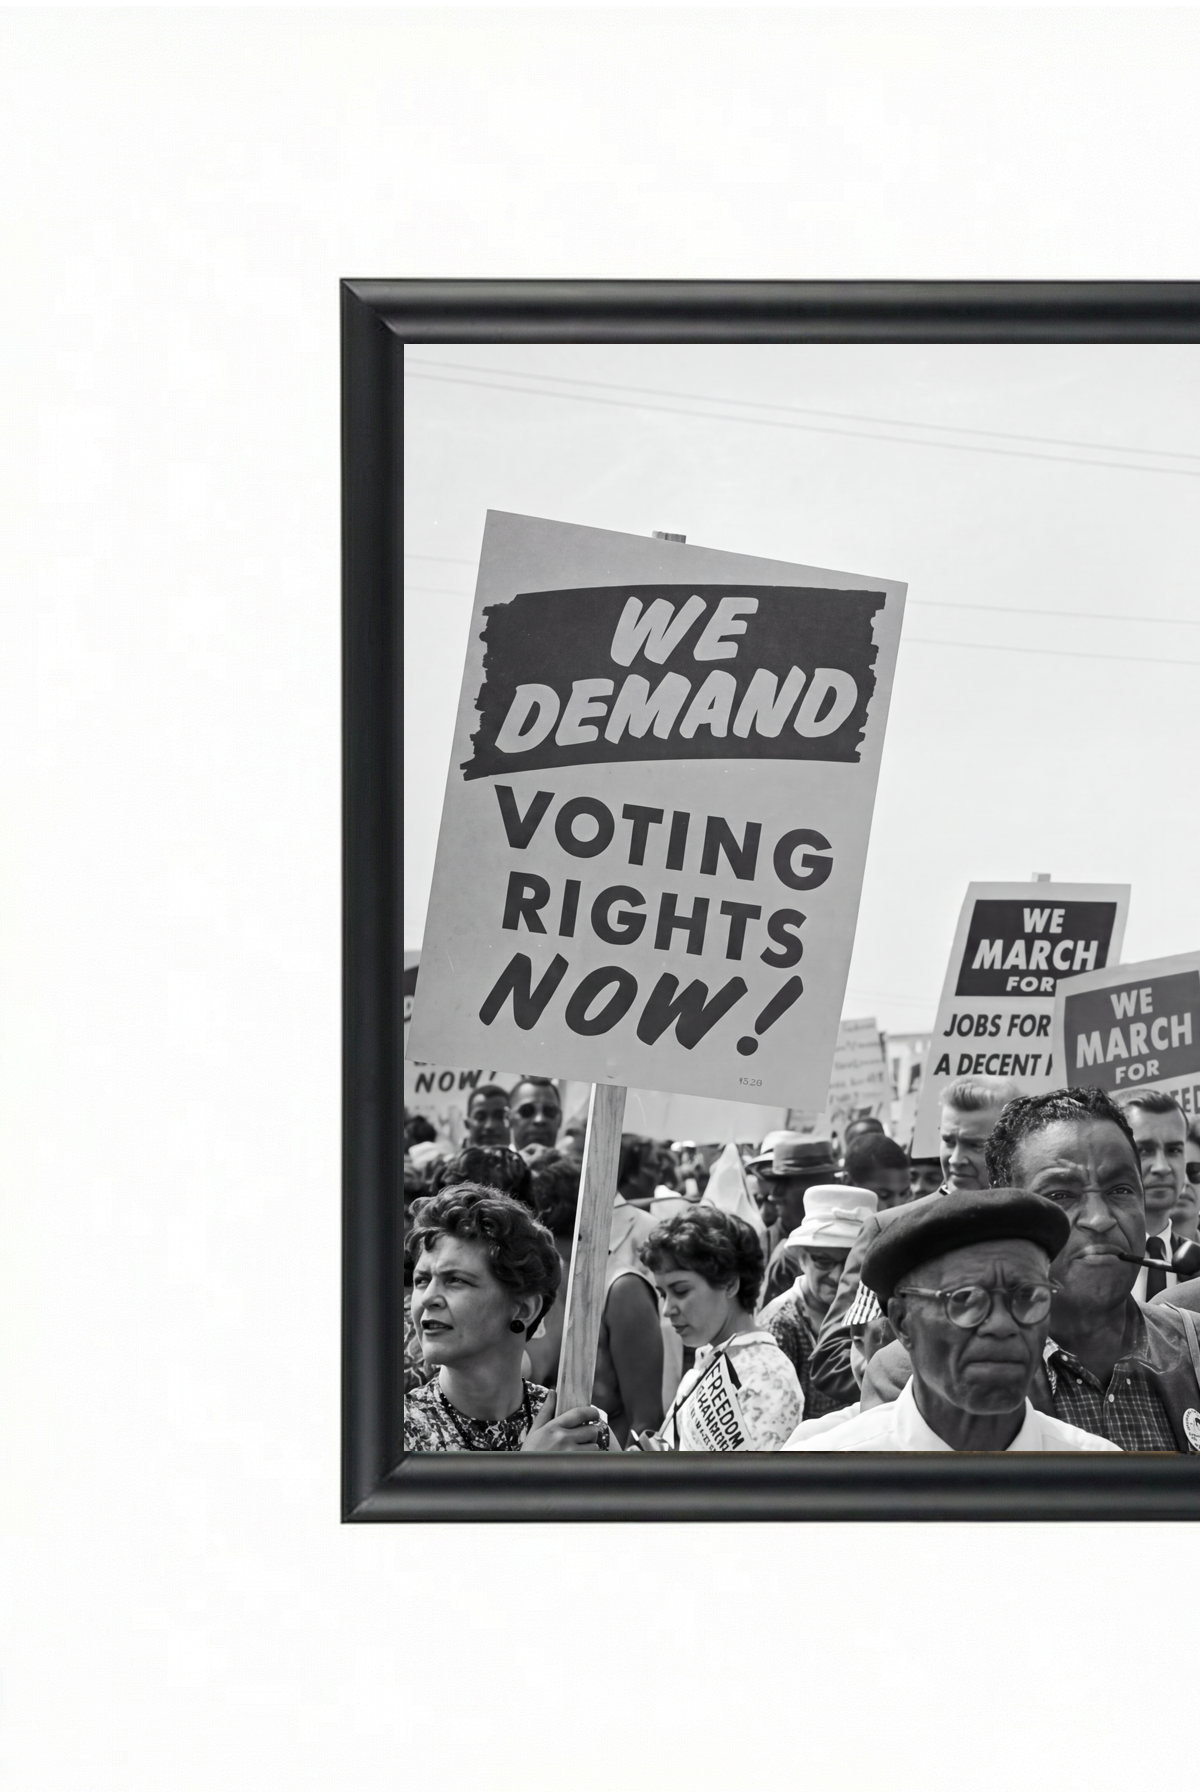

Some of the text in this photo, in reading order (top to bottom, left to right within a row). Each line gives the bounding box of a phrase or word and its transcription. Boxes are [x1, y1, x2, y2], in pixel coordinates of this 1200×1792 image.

[610, 595, 759, 667] WE
[494, 665, 858, 754] DEMAND
[494, 784, 834, 891] VOTING
[502, 871, 807, 968] RIGHTS
[1023, 908, 1066, 934] WE
[971, 939, 1098, 971] MARCH
[479, 952, 804, 1056] NOW!
[1006, 976, 1054, 992] FOR
[1110, 987, 1154, 1020] WE
[943, 1014, 1052, 1037] JOBS FOR
[1076, 1012, 1193, 1069] MARCH
[933, 1053, 951, 1076] A
[956, 1053, 1043, 1076] DECENT
[1115, 1059, 1160, 1085] FOR
[705, 1362, 744, 1450] FREEDOM
